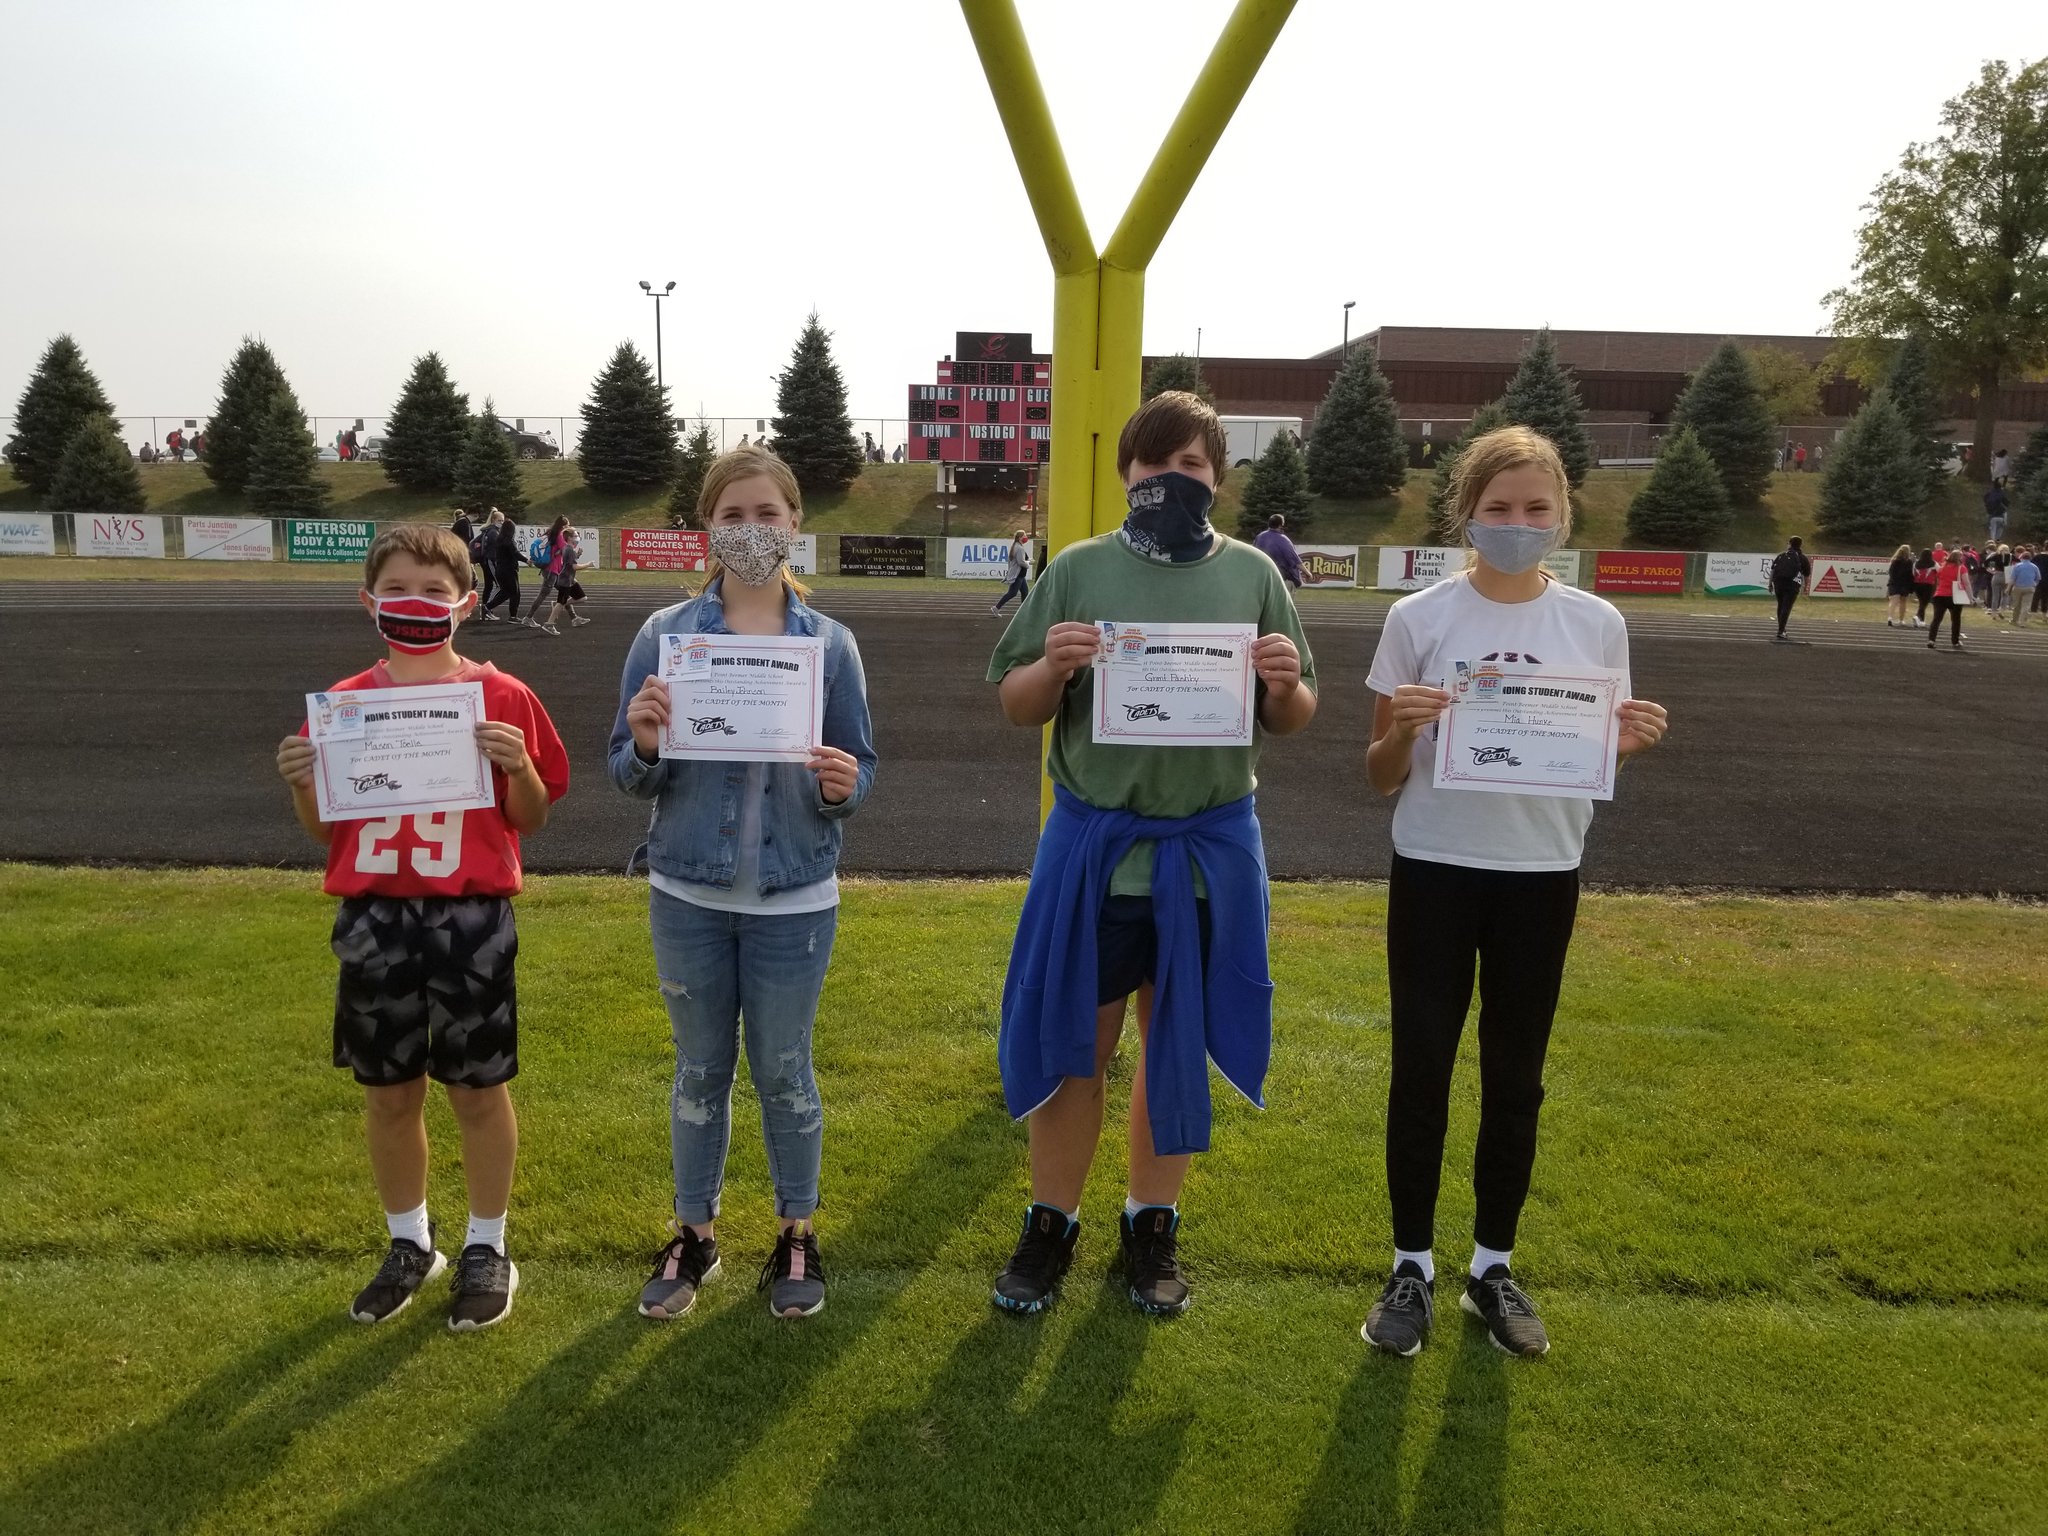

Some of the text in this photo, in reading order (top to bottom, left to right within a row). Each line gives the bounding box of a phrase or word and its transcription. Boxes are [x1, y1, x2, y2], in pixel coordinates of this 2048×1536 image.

[920, 386, 953, 401] HOME
[970, 387, 1016, 402] PERIOD
[1027, 389, 1049, 403] GUE
[922, 424, 951, 438] DOWN
[969, 425, 1015, 439] YDS TO GO
[187, 520, 238, 529] Parts Junction
[296, 522, 366, 535] PETERSON
[0, 524, 40, 537] WAVE
[583, 530, 597, 540] Inc.
[633, 531, 680, 541] ORTMEIER
[293, 536, 370, 547] BODY & PAINT
[627, 540, 704, 550] ASSOCIATES INC.
[223, 543, 271, 553] Jones Grinding
[306, 548, 326, 556] Service
[1415, 550, 1445, 561] First
[1312, 556, 1354, 578] Ranch
[1711, 559, 1736, 567] banking
[790, 565, 805, 574] EDS
[1414, 567, 1441, 577] Bank
[1599, 565, 1682, 576] WELLS FARGO
[1123, 642, 1142, 650] FREE
[690, 651, 708, 659] FREE
[1145, 646, 1233, 658] NDING STUDENT AWARD
[711, 657, 799, 672] NDING STUDENT AWARD
[1477, 680, 1498, 688] FREE
[1502, 686, 1597, 703] DING STUDENT AWARD
[340, 707, 359, 718] FREE
[364, 710, 459, 723] NDING STUDENT AWARD
[1547, 730, 1579, 739] MONTH
[363, 754, 390, 763] CADET
[421, 749, 451, 757] MONTH
[354, 809, 464, 878] 29
